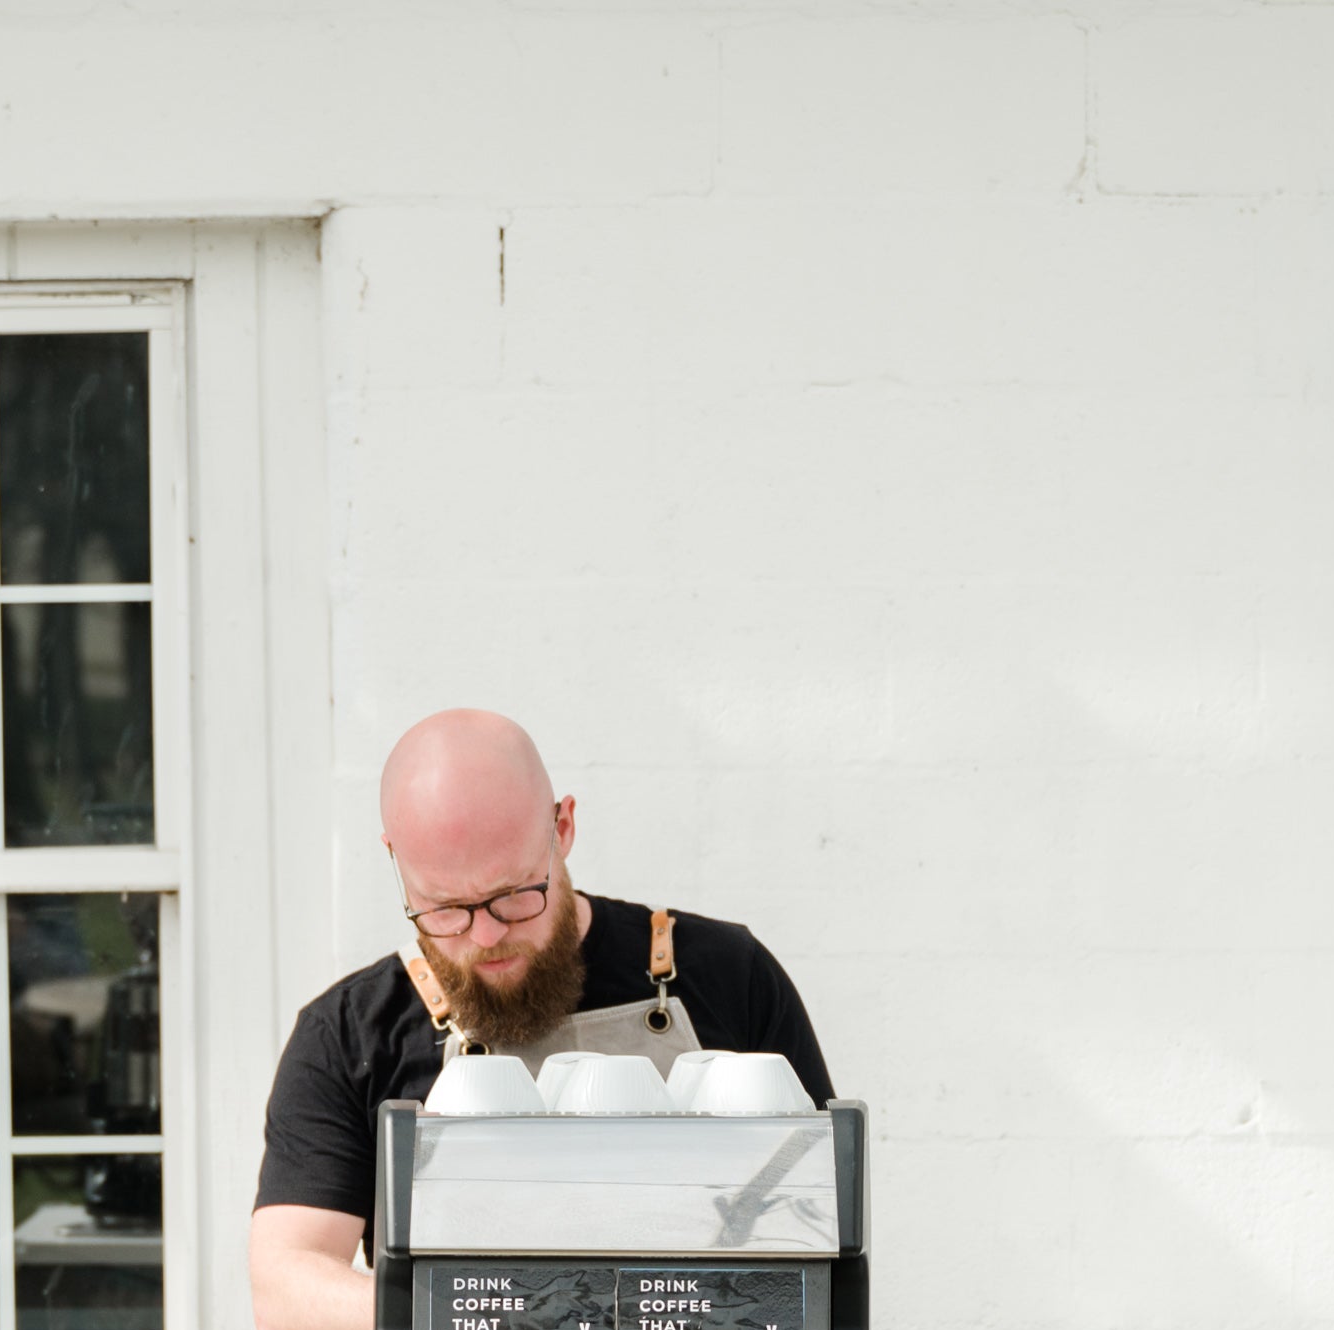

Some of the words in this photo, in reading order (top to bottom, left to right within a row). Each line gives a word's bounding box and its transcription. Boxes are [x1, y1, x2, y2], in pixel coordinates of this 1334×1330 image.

[453, 1277, 512, 1291] DRINK
[640, 1279, 699, 1292] DRINK
[452, 1297, 525, 1311] COFFEE
[639, 1299, 711, 1313] COFFEE
